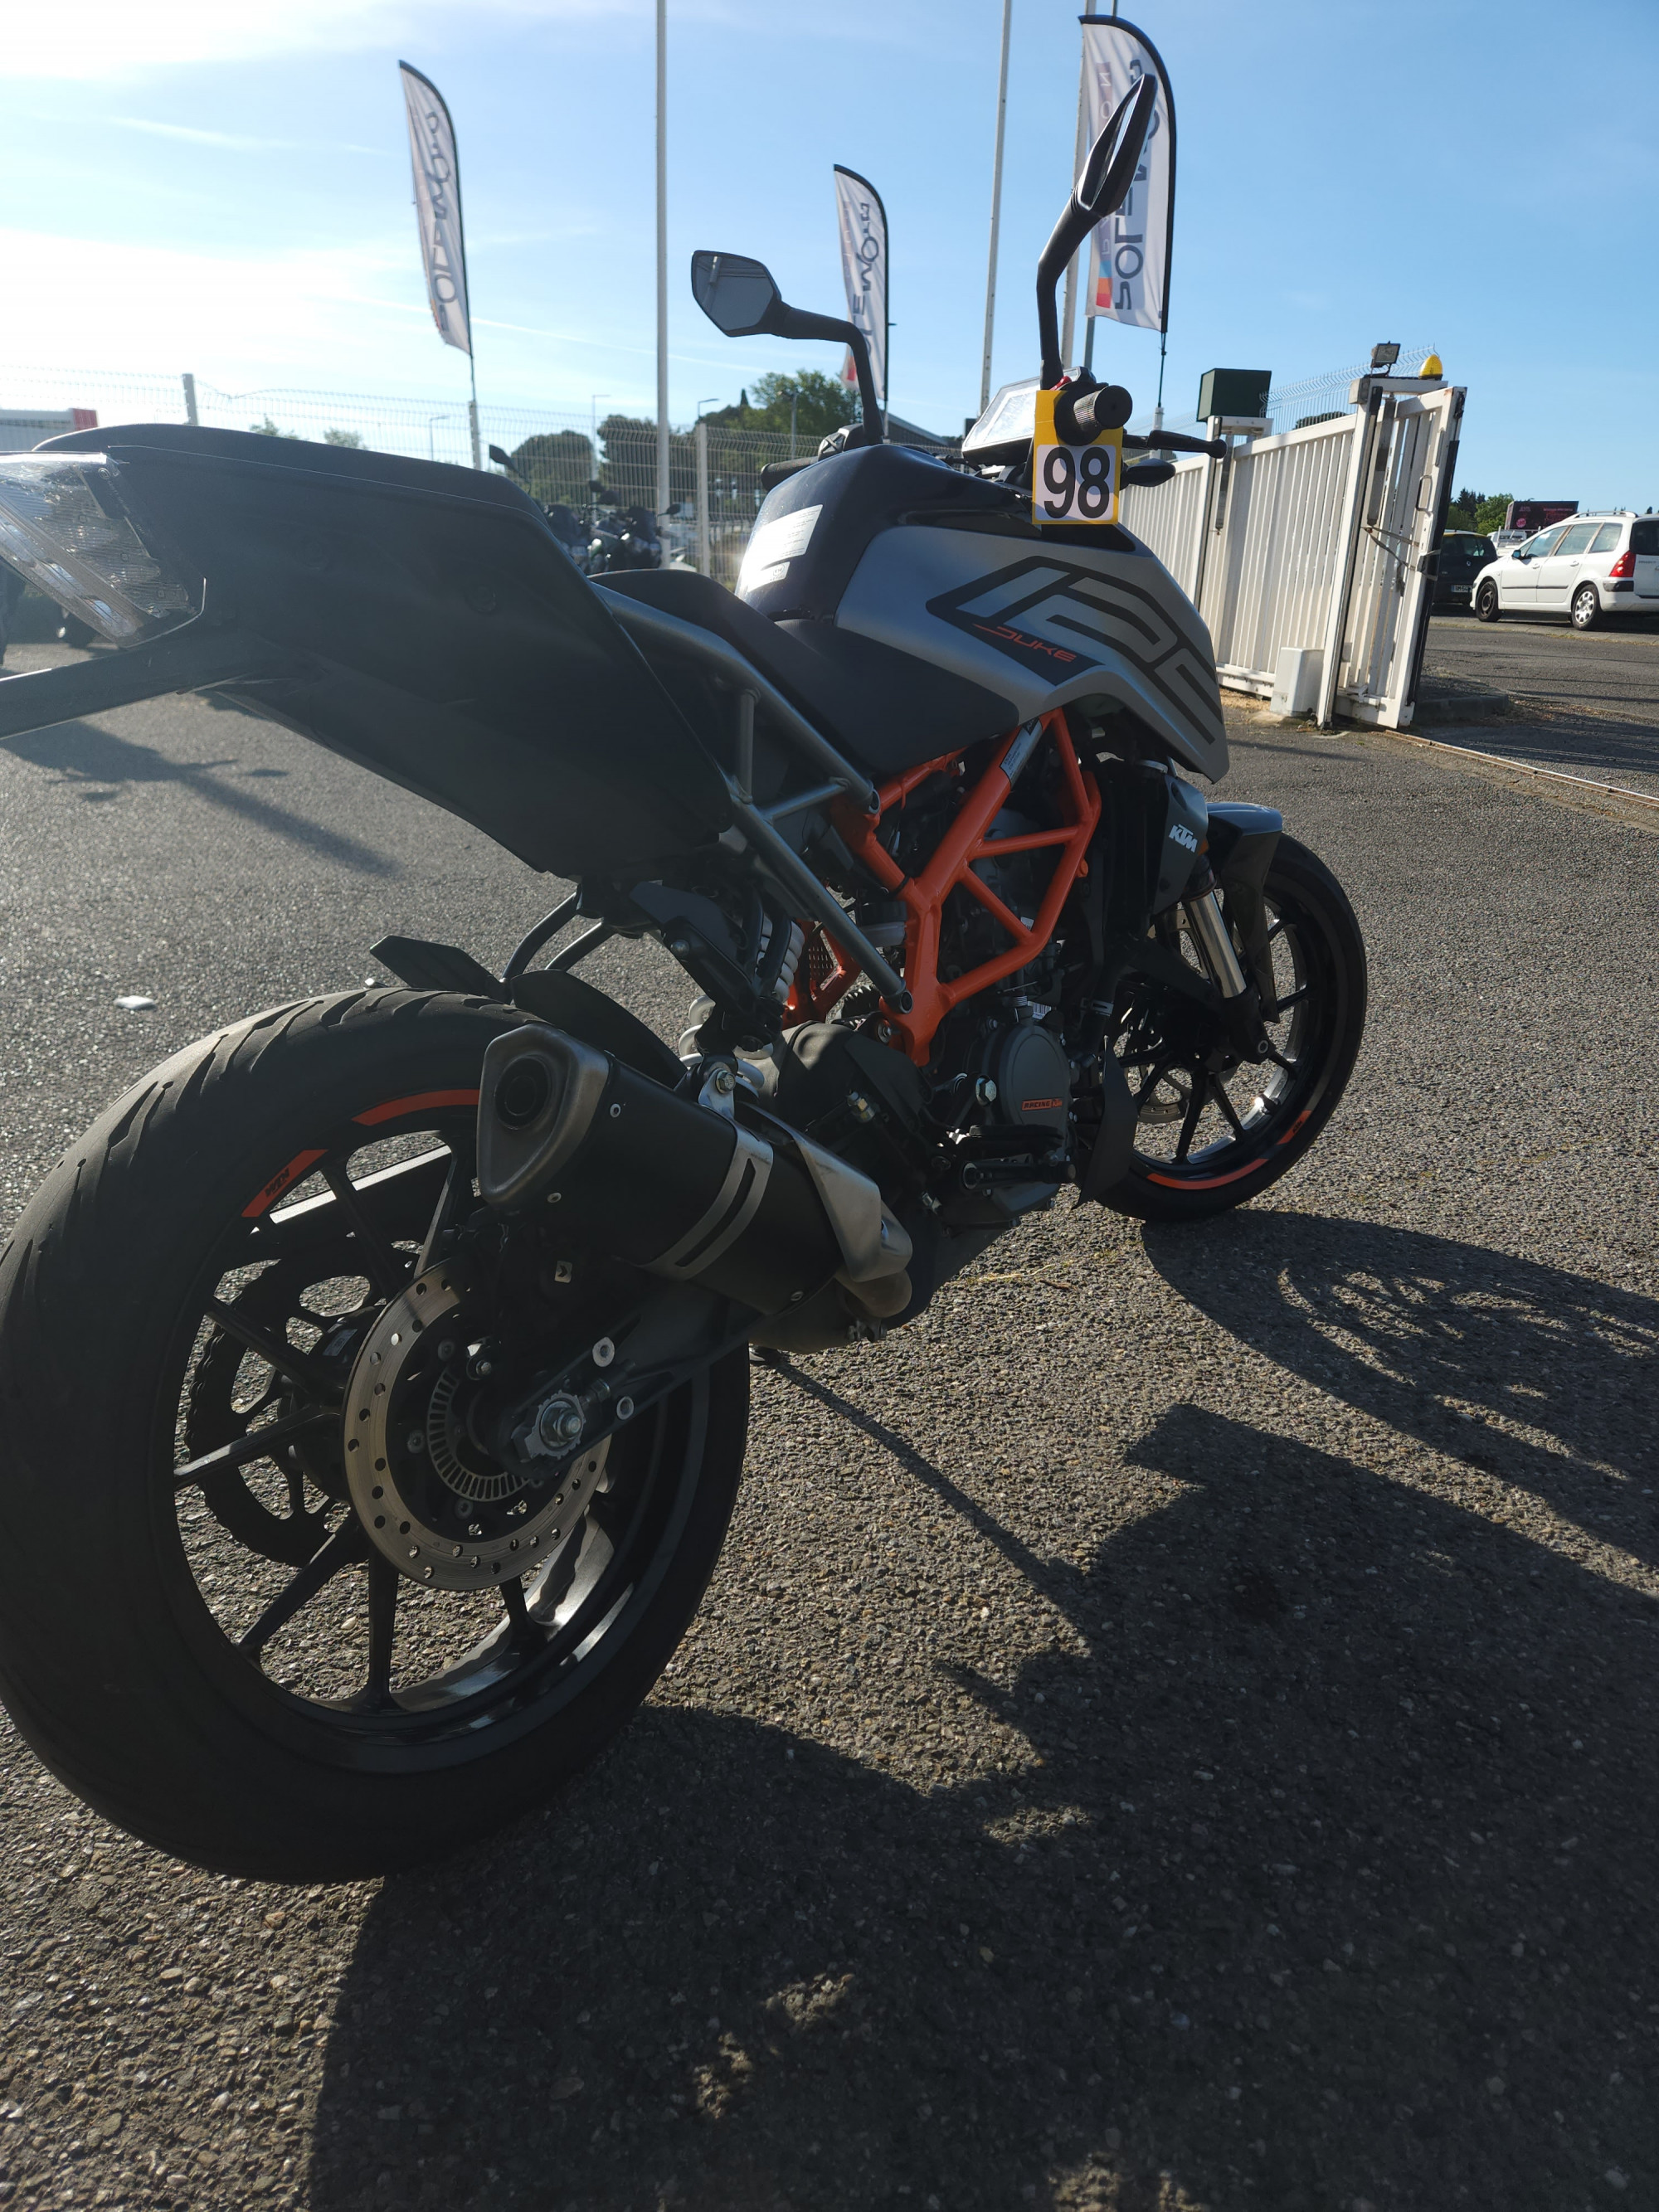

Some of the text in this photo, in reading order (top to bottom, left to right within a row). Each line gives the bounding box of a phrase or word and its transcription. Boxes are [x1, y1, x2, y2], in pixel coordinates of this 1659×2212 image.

[1044, 446, 1110, 519] 98
[973, 623, 1078, 663] DUKE
[1169, 823, 1198, 853] KTM
[1024, 1101, 1050, 1109] RACING
